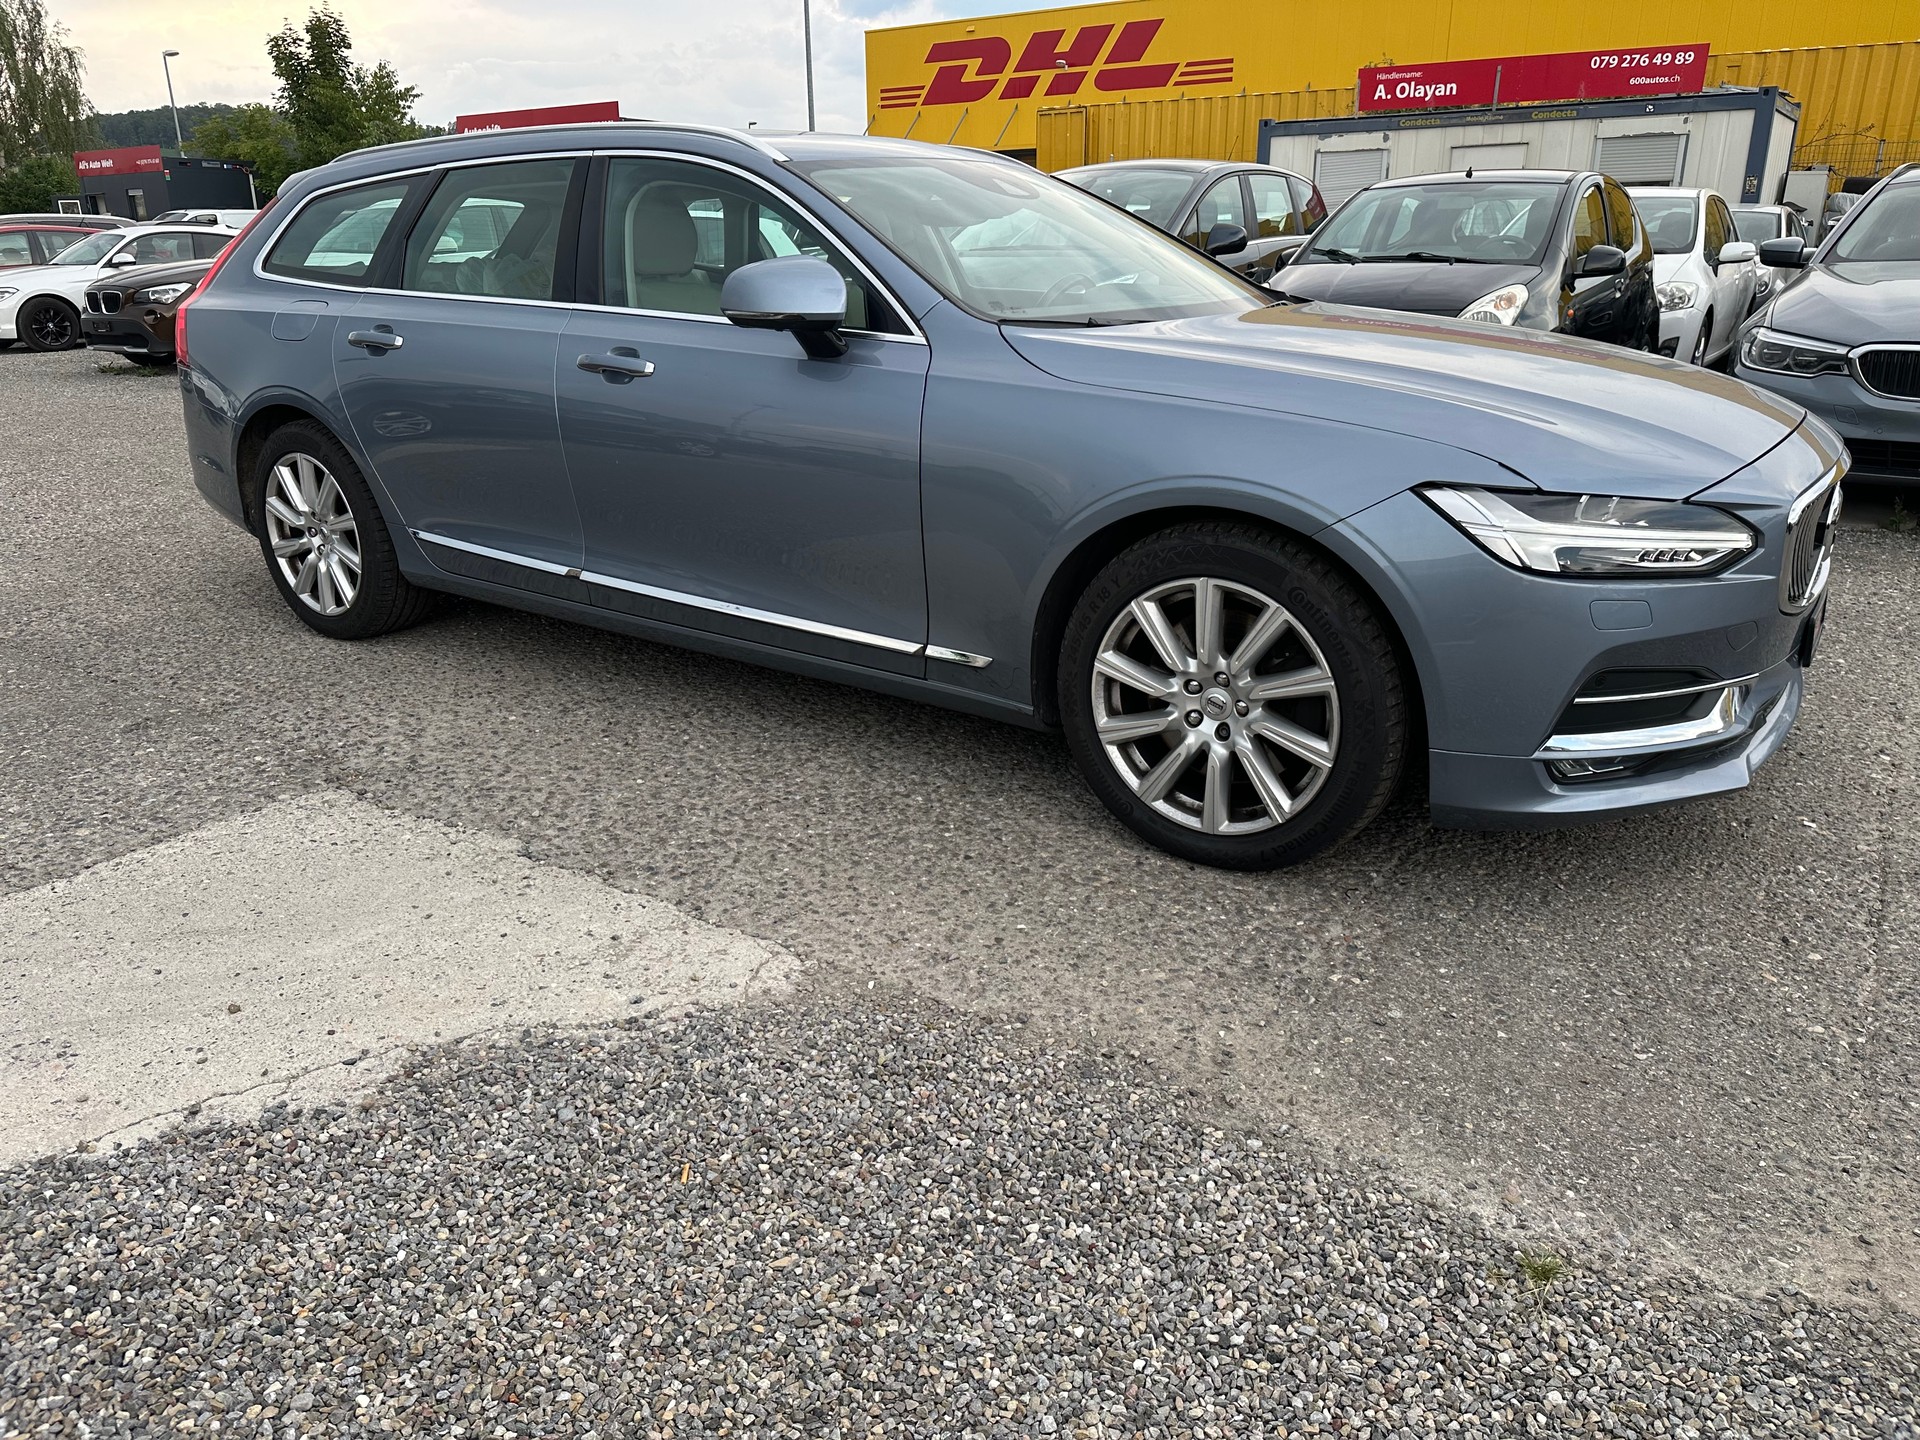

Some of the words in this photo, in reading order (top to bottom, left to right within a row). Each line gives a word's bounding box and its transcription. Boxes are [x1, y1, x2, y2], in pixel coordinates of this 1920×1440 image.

[921, 18, 1180, 106] DHL
[1590, 55, 1619, 69] 079
[1620, 53, 1650, 67] 276
[1652, 52, 1672, 66] 49
[1674, 51, 1695, 65] 89
[1376, 71, 1423, 80] Händlername:
[1629, 74, 1681, 85] 600autos.ch
[1373, 84, 1392, 100] A.
[1395, 81, 1457, 102] Olayan
[1400, 118, 1441, 127] Condecta
[1531, 109, 1578, 121] Condecta
